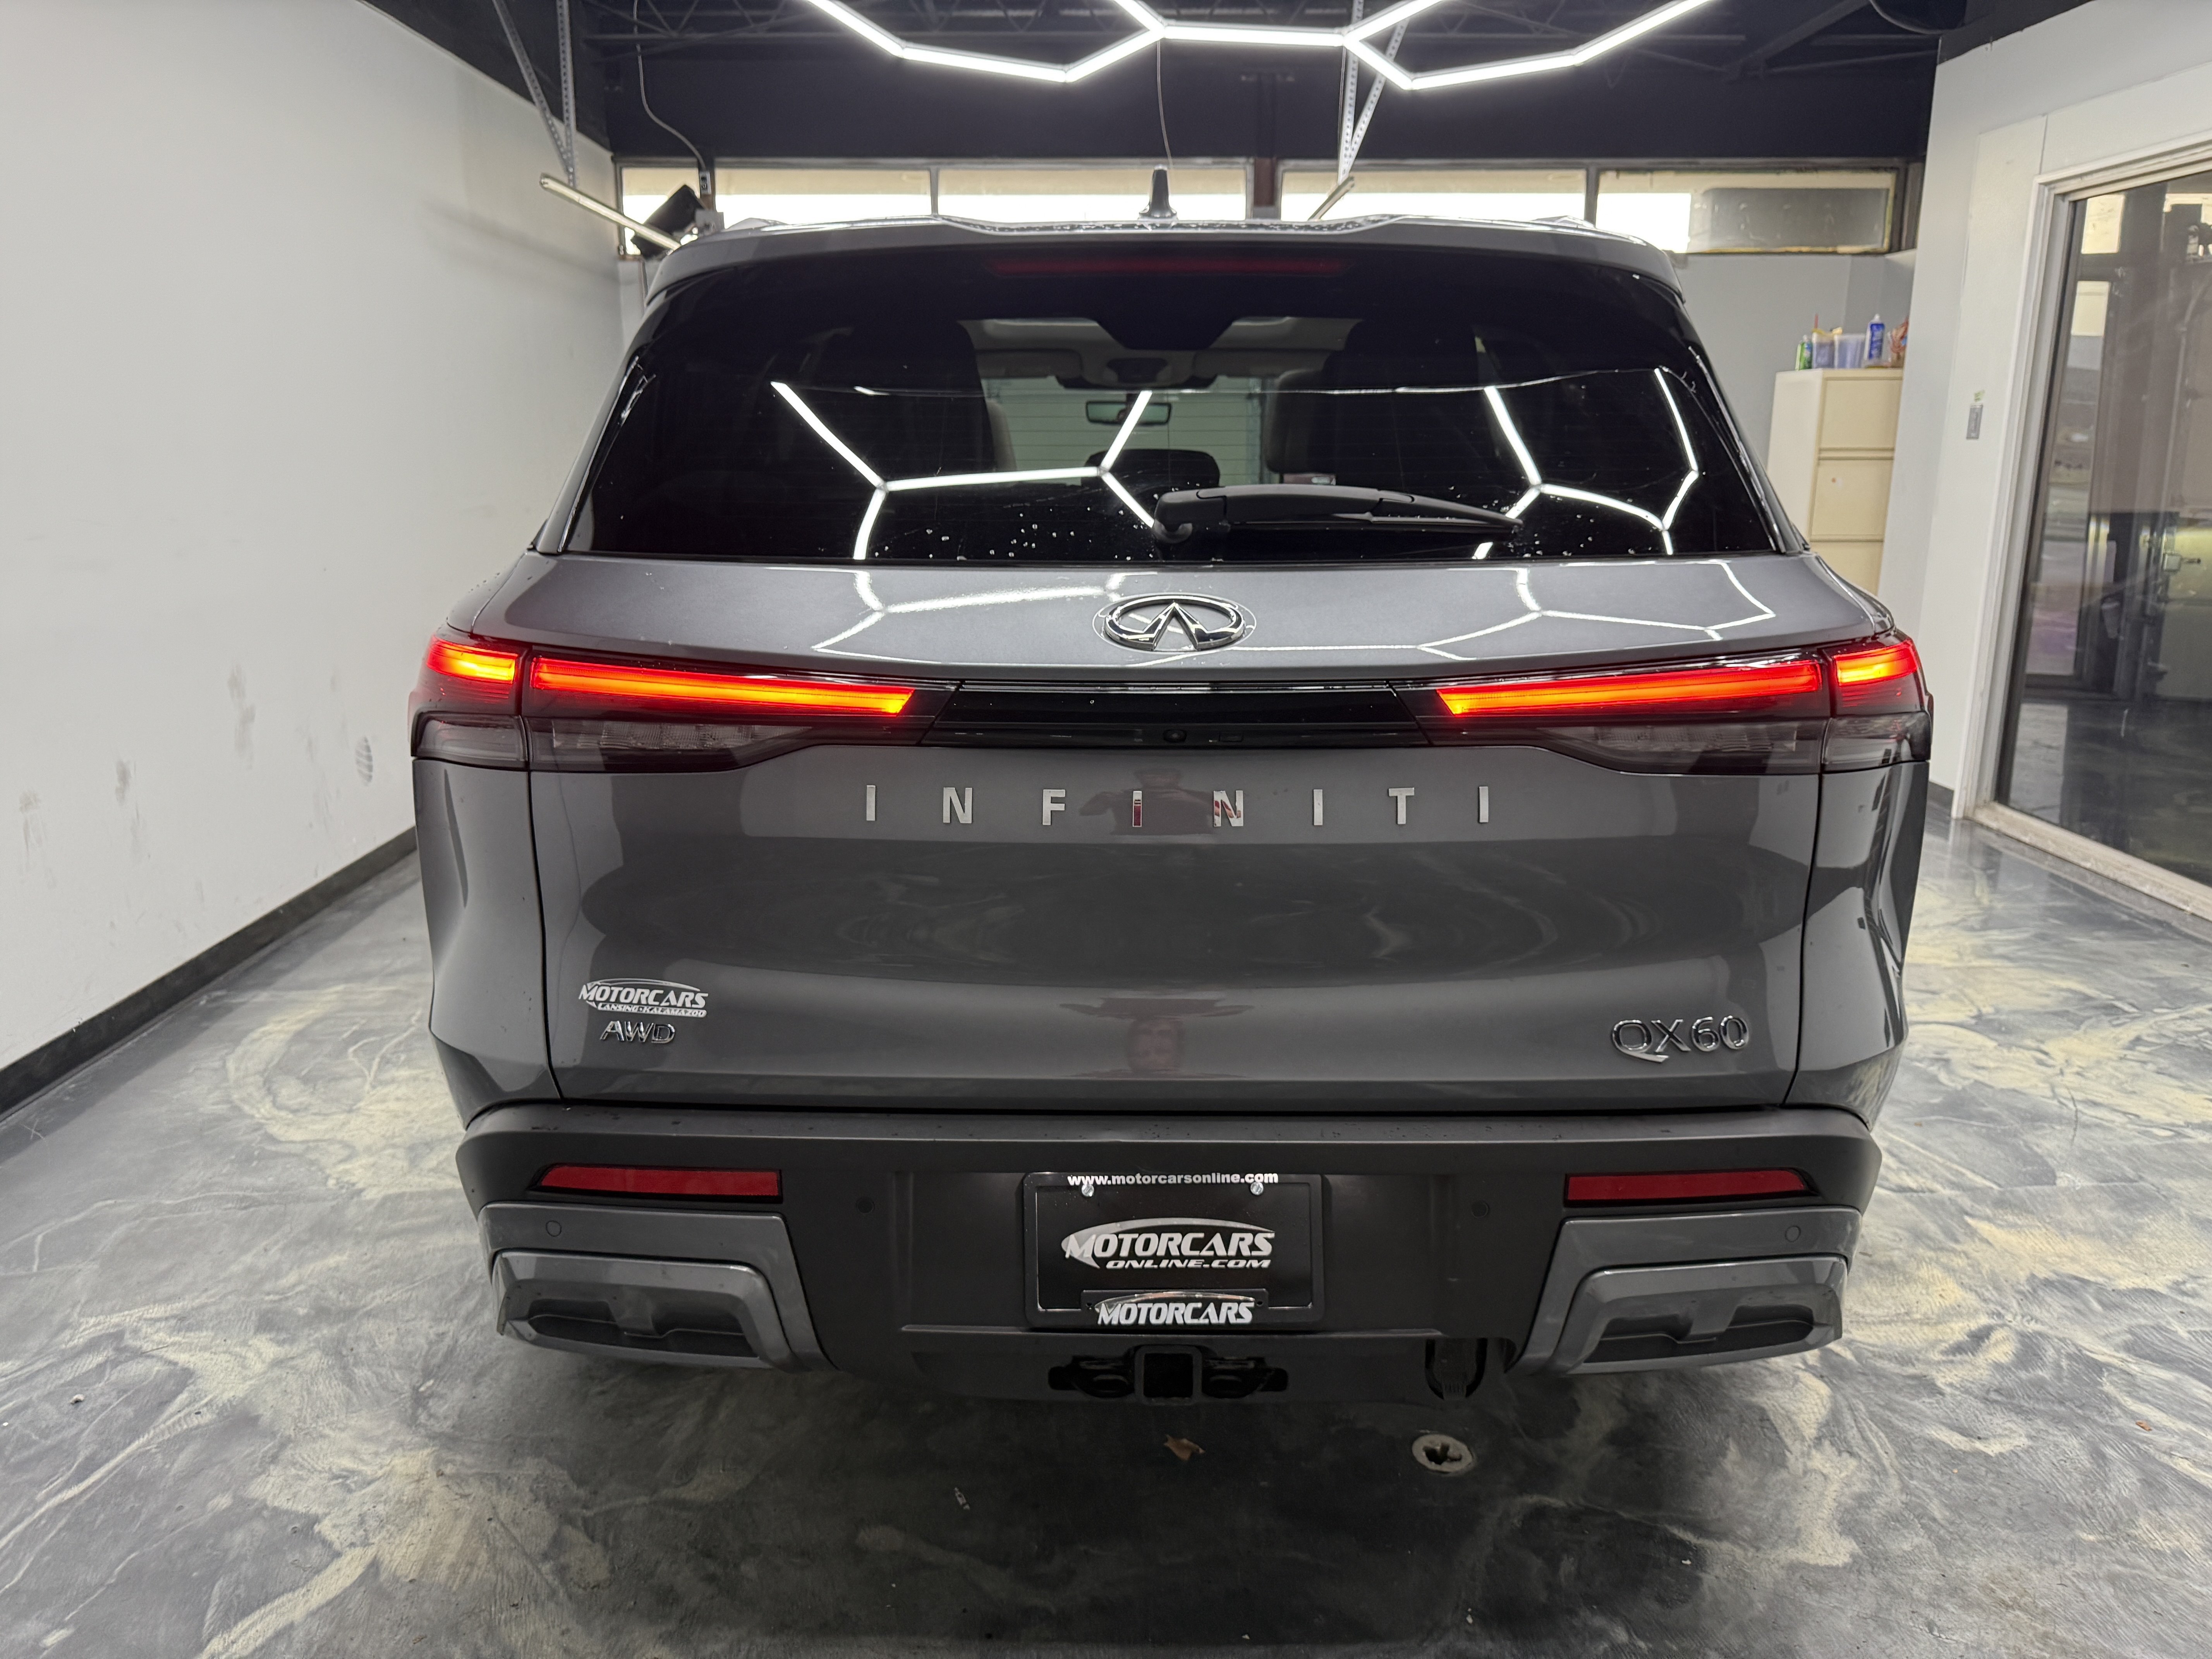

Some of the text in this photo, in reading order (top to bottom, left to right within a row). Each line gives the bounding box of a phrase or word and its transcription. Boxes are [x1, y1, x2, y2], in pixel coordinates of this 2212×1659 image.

[866, 785, 1489, 827] INFINITI
[579, 985, 708, 1008] MOTORCARS
[600, 1020, 675, 1043] AWD
[1612, 1015, 1750, 1062] QX60
[1068, 1173, 1278, 1186] www.motorcarsonline.com
[1065, 1233, 1275, 1258] MOTORCARS
[1106, 1259, 1271, 1268] ONLINE.COM
[1097, 1302, 1254, 1325] MOTORCARS
